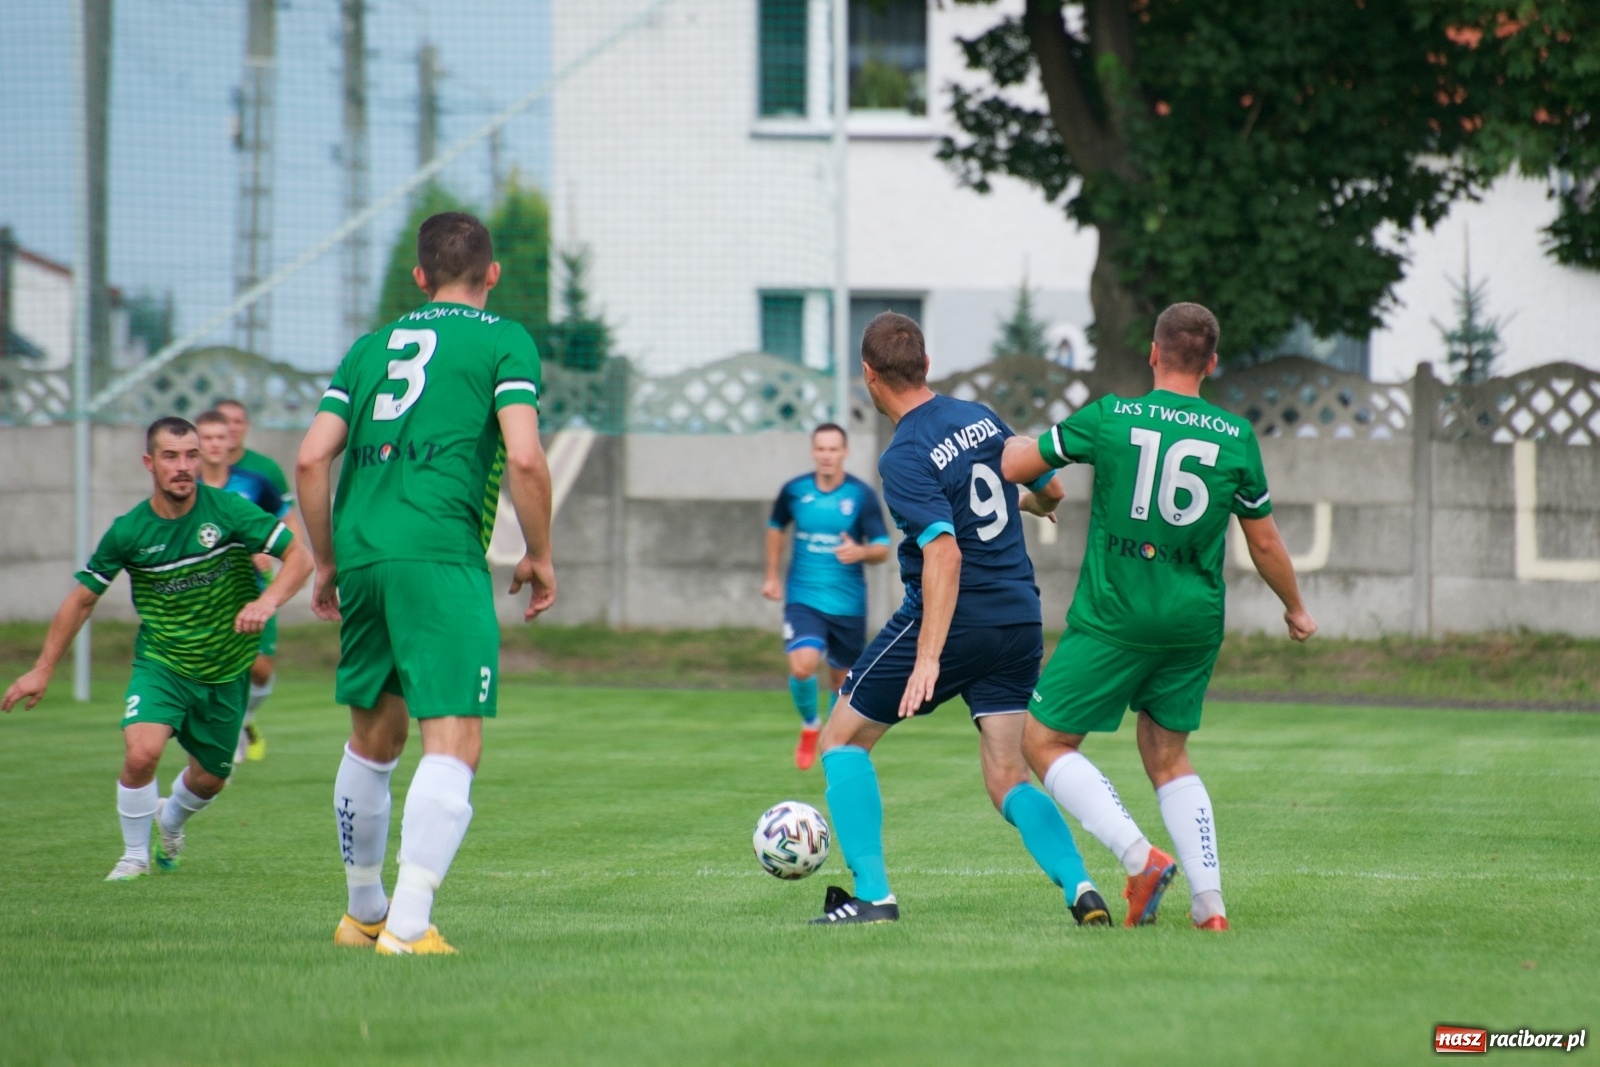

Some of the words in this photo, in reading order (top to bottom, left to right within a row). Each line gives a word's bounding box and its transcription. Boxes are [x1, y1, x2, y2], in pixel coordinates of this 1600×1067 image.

[372, 328, 437, 421] 3
[1114, 400, 1143, 416] LKS
[1148, 404, 1240, 438] TWORKÓW
[970, 462, 1009, 542] 9
[1130, 427, 1220, 527] 16
[124, 695, 141, 719] 2
[479, 666, 491, 703] 3
